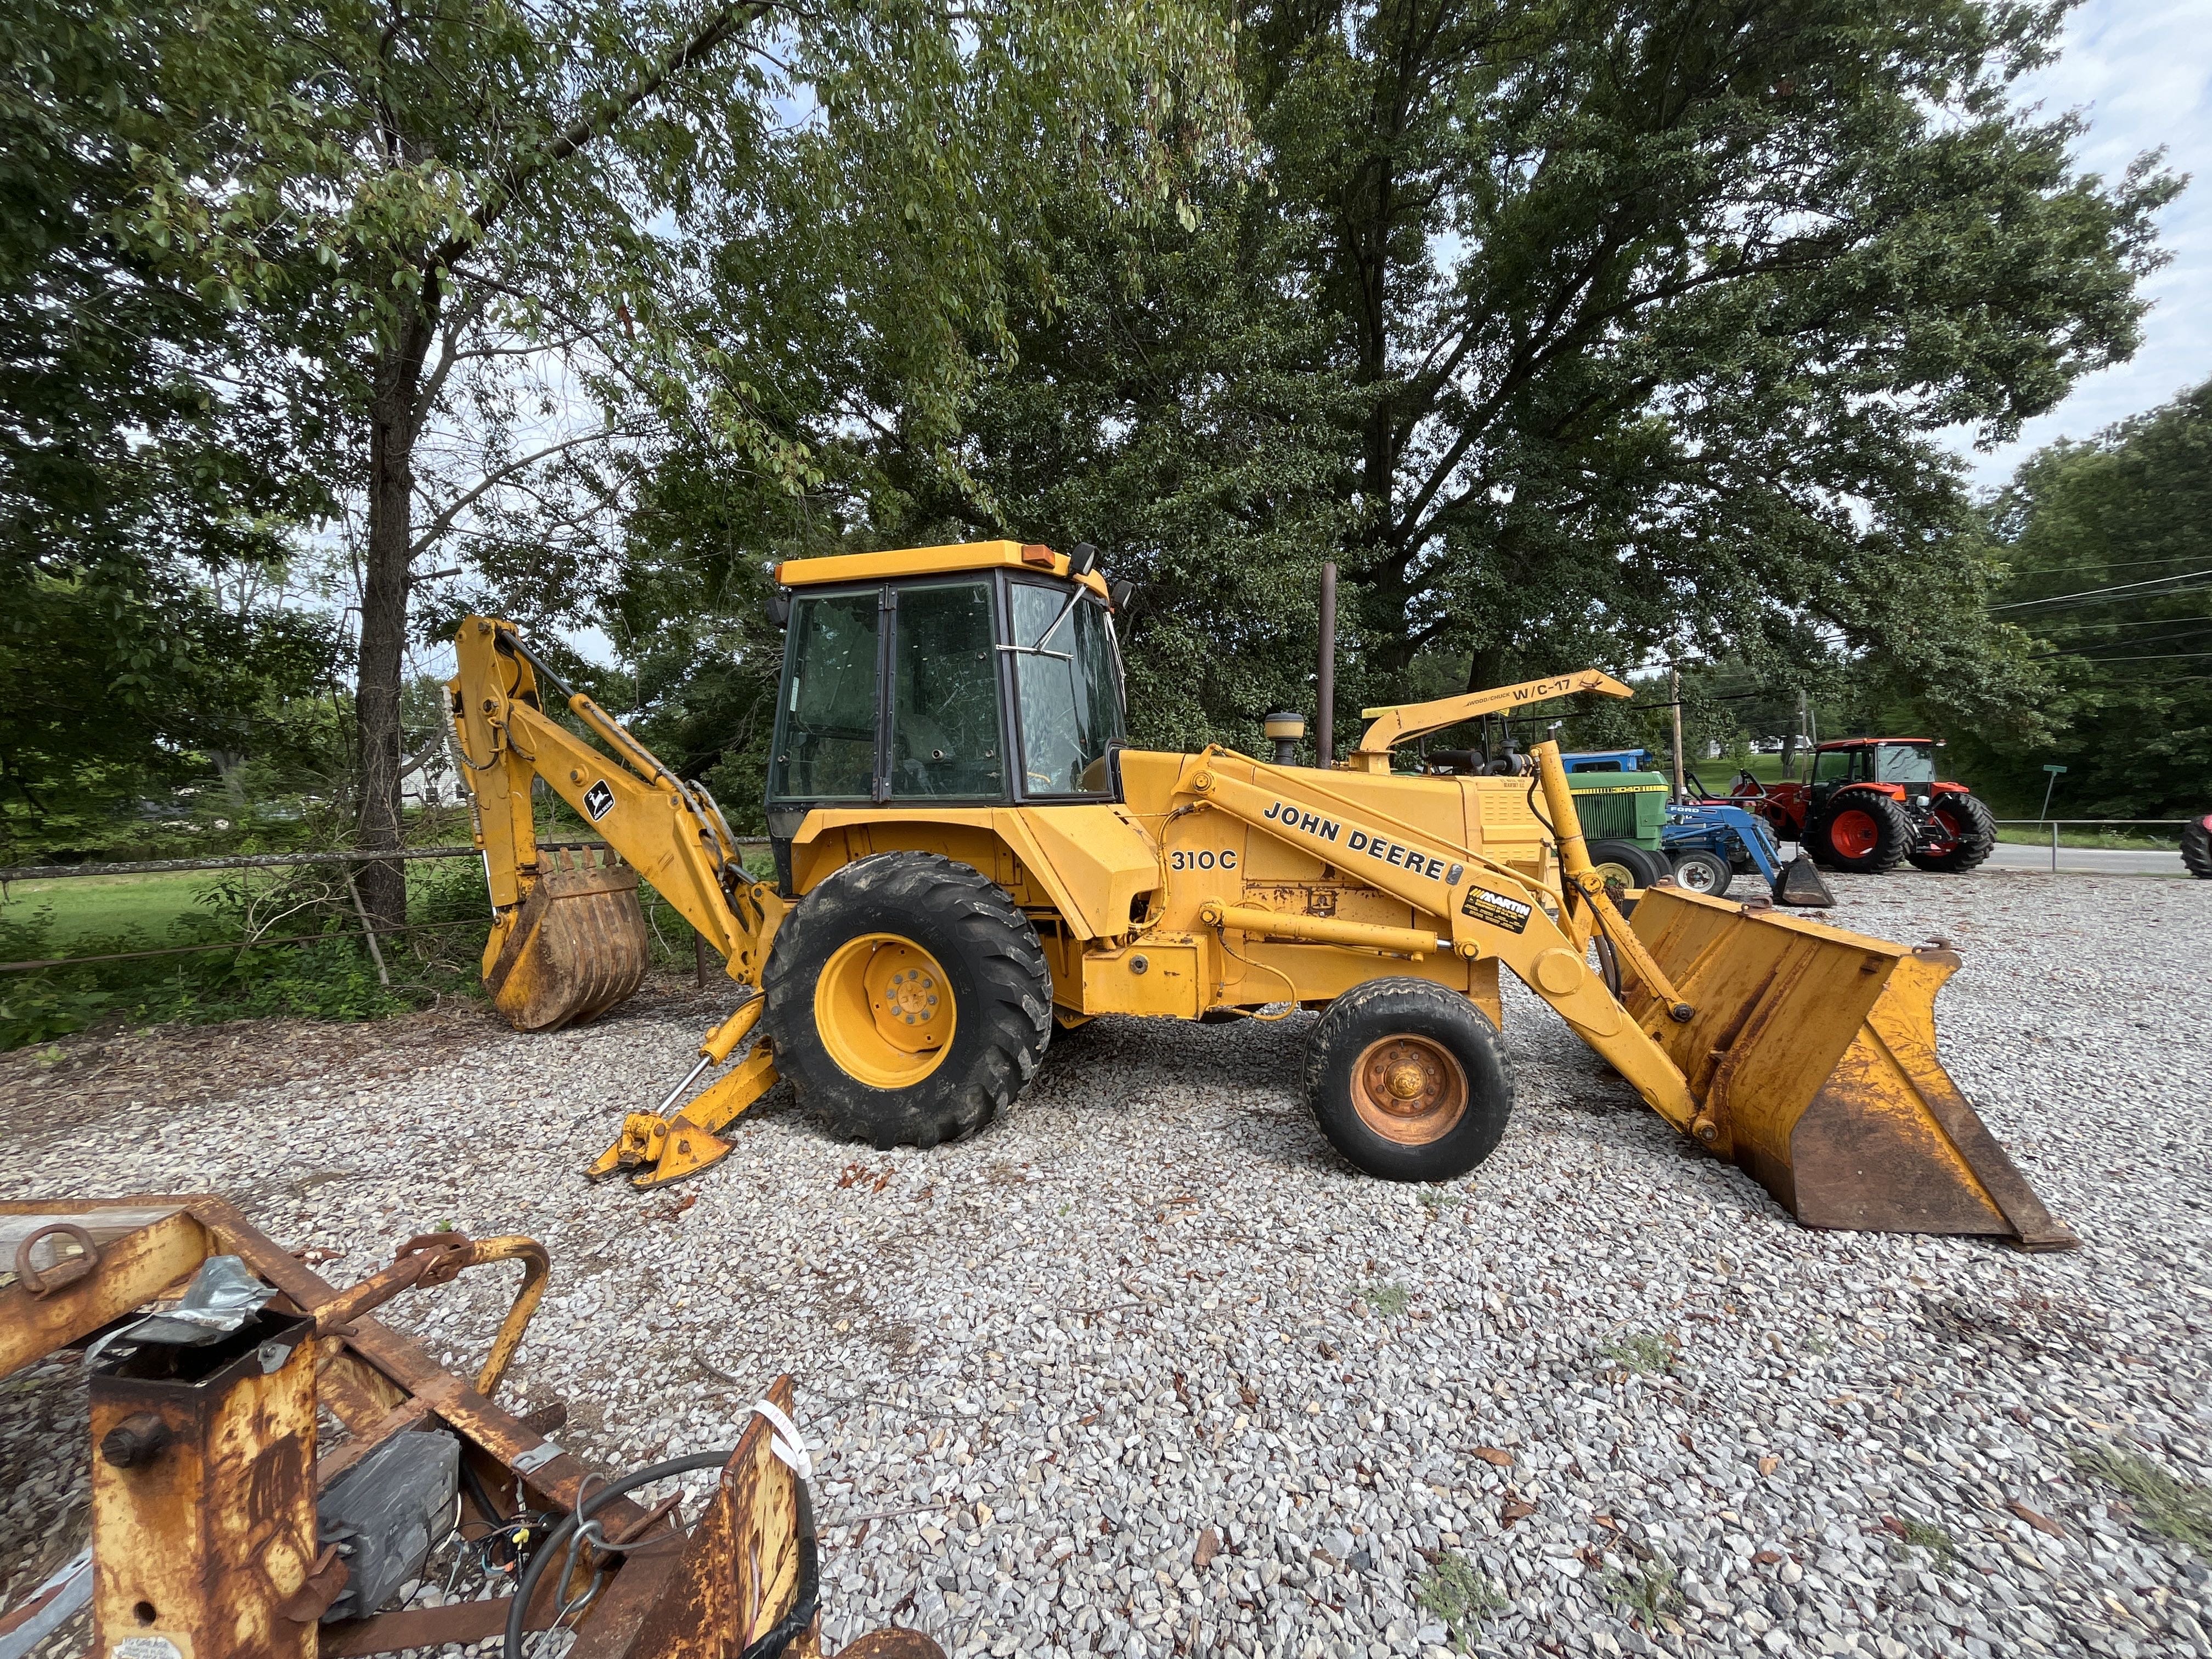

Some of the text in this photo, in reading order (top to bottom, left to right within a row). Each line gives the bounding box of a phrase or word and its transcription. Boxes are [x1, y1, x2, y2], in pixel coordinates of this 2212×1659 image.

[1468, 679, 1570, 706] WOOD/CHUCK W/C-17
[1263, 801, 1446, 881] JOHN DEERE
[1480, 891, 1530, 916] MARTIN
